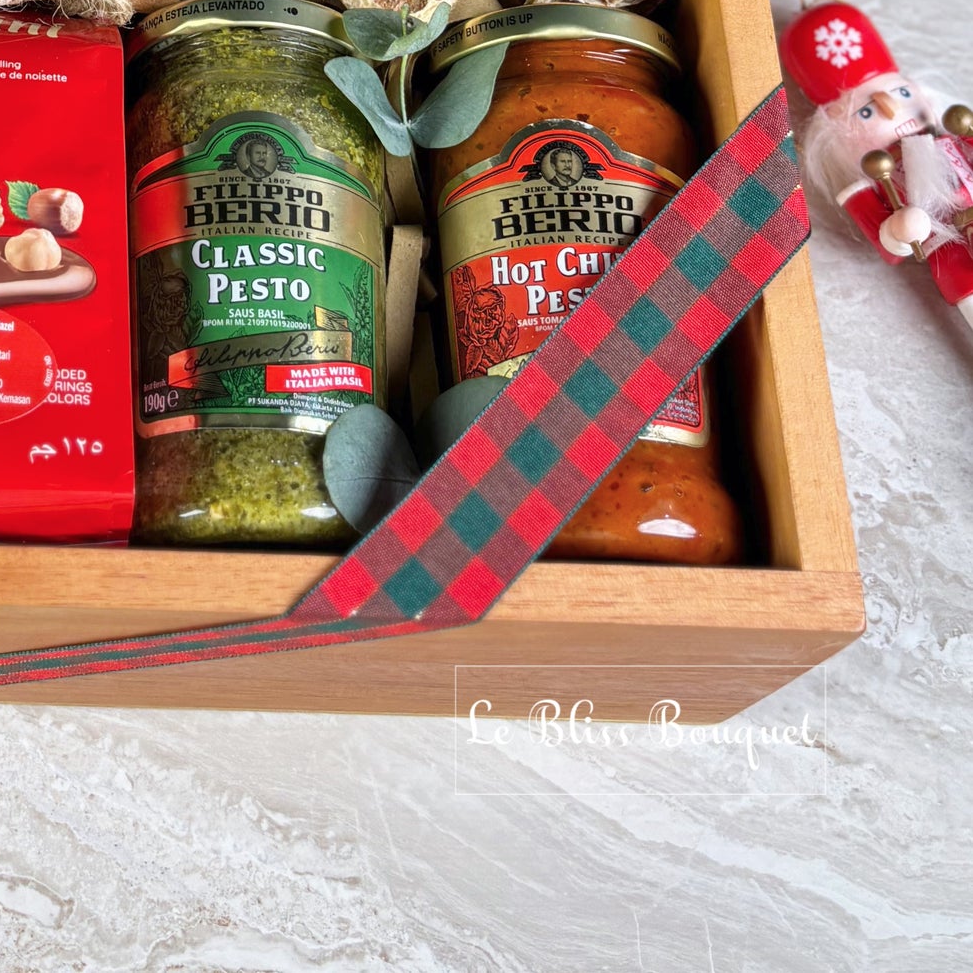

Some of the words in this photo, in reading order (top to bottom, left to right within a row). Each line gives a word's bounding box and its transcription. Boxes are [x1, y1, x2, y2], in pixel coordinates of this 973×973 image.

[165, 4, 200, 21] ESTEJA
[201, 0, 266, 13] LEVANTADO
[465, 18, 505, 38] BUTTON
[519, 13, 534, 24] UP
[9, 70, 23, 80] de
[25, 72, 68, 82] noisette
[194, 183, 323, 206] FILIPPO
[524, 185, 553, 193] SINCE
[499, 192, 634, 214] FILIPPO
[184, 200, 331, 233] BERIO
[492, 208, 643, 242] BERIO
[201, 227, 256, 236] ITALIAN
[265, 227, 313, 240] RECIPE
[510, 235, 565, 248] ITALIAN
[575, 235, 625, 246] RECIPE
[191, 239, 327, 271] CLASSIC
[490, 256, 546, 287] HOT
[557, 247, 622, 277] CHI
[207, 273, 312, 304] PESTO
[527, 284, 591, 315] PES
[229, 308, 255, 318] SAUS
[258, 309, 286, 319] BASIL
[517, 318, 538, 327] SAUS
[285, 376, 333, 388] ITALIAN
[334, 376, 363, 387] BASIL
[291, 368, 327, 378] MADE
[328, 366, 355, 376] WITH
[47, 391, 91, 405] OLORS
[62, 437, 103, 456] ١٢٥
